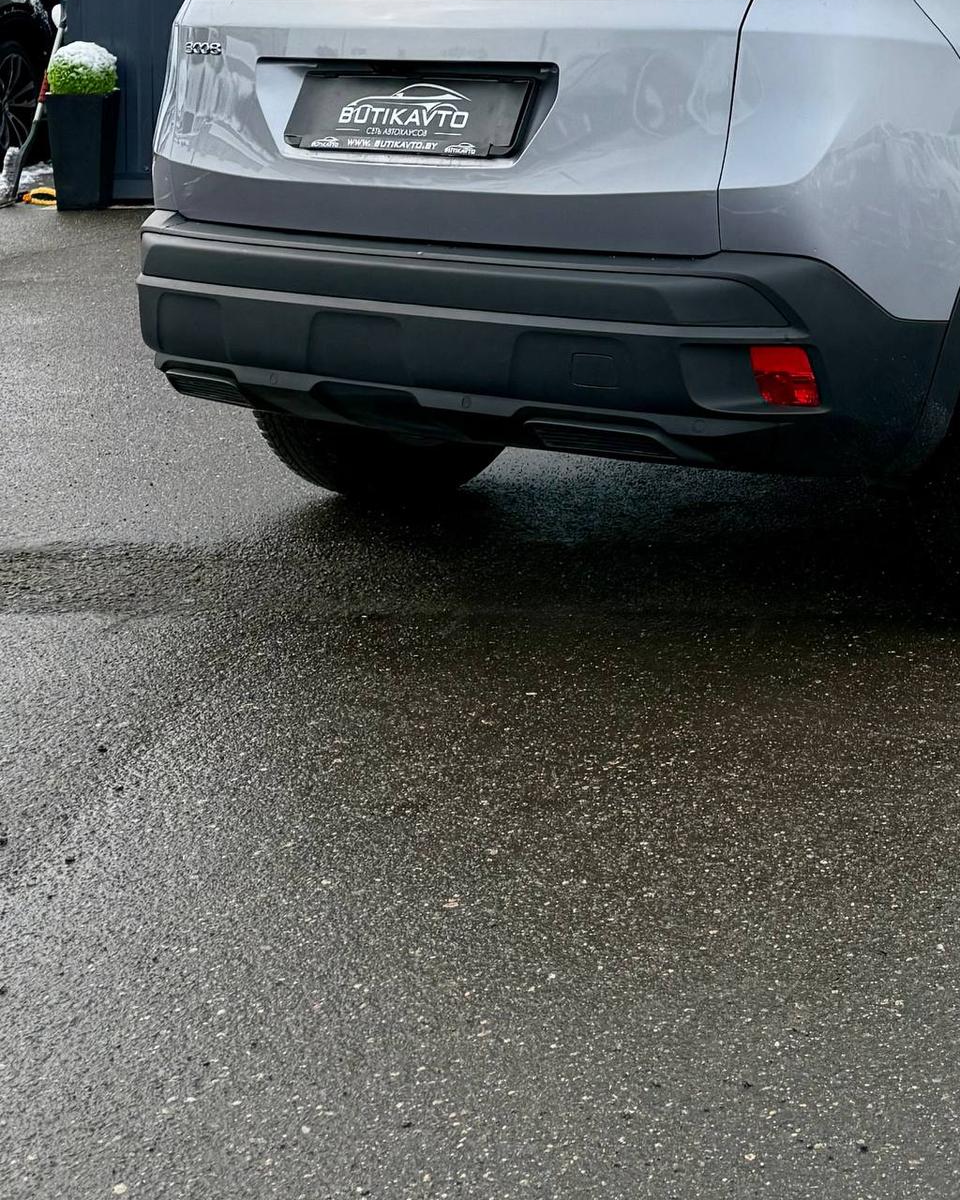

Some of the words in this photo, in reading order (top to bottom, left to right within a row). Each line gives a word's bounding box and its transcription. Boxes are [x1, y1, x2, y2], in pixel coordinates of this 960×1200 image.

[337, 105, 469, 129] BUTIKAVTO
[383, 127, 428, 137] АВТОХАУСОВ
[347, 137, 371, 147] WWW.
[374, 139, 439, 150] BUTIKAVTO.BY
